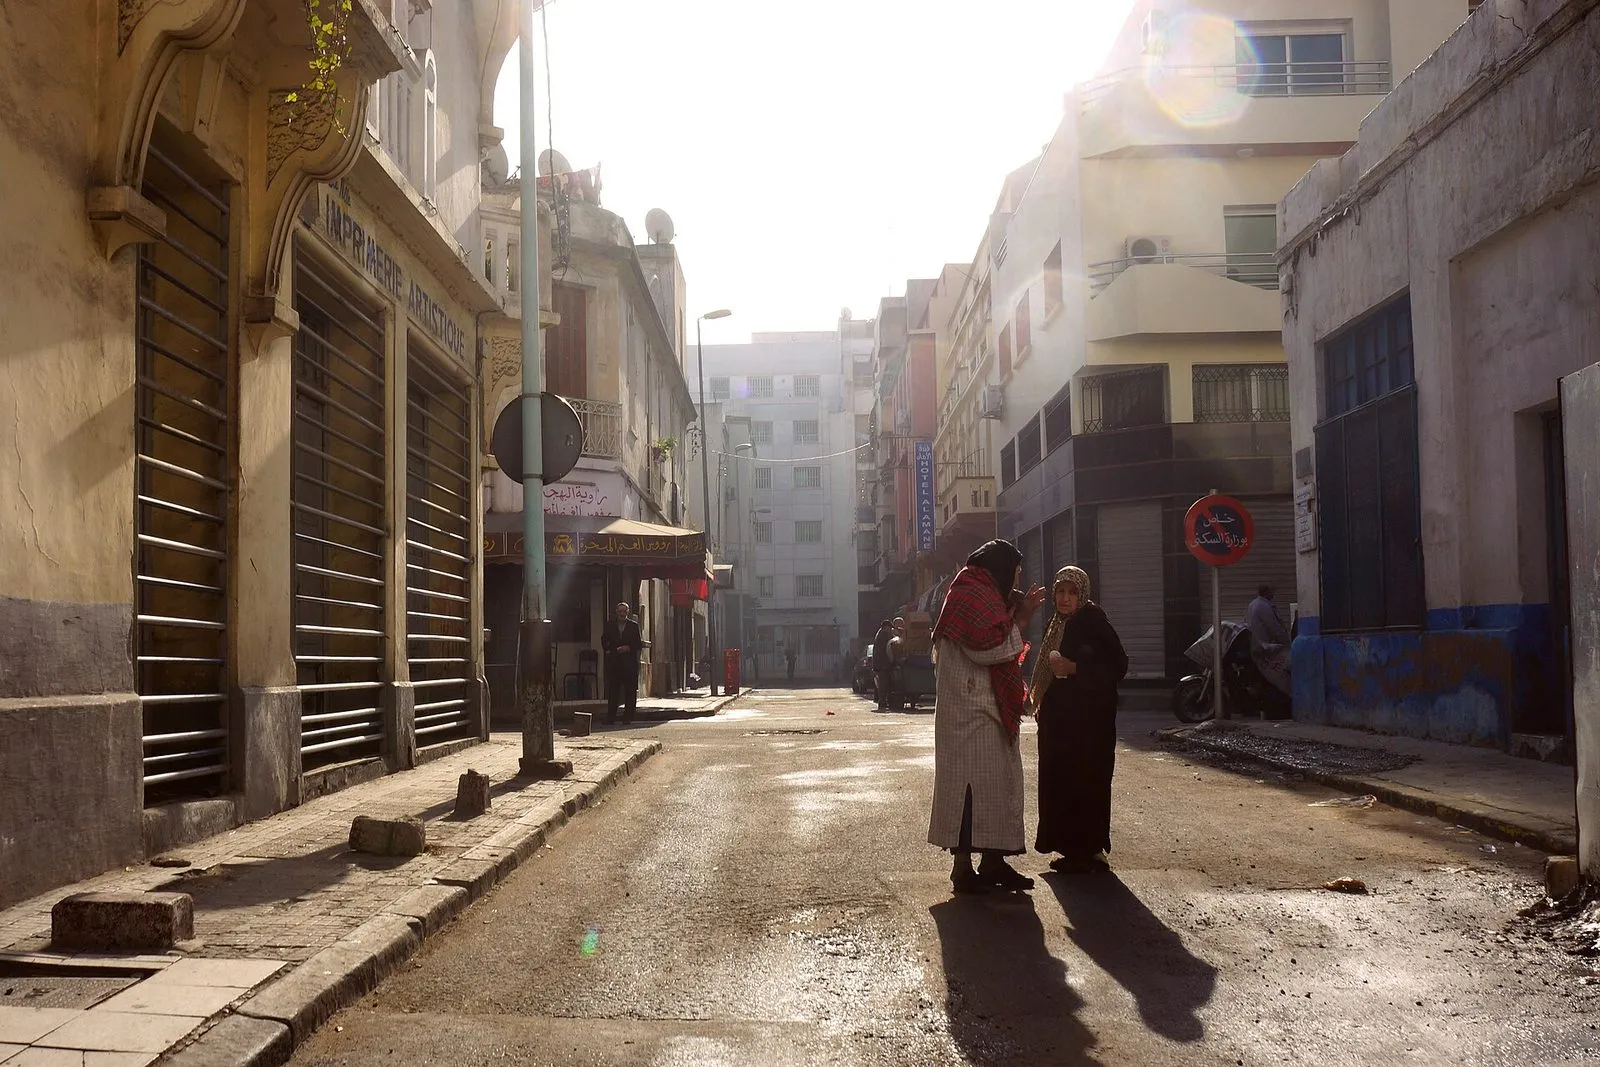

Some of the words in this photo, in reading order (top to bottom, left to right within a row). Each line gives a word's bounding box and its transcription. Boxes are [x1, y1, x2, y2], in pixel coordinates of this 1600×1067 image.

[326, 193, 404, 302] IMPRIMERIE
[407, 278, 466, 362] ARTISTIQUE
[920, 460, 930, 495] HOTEL
[1202, 512, 1236, 528] خاص
[1224, 532, 1249, 549] بوزارة
